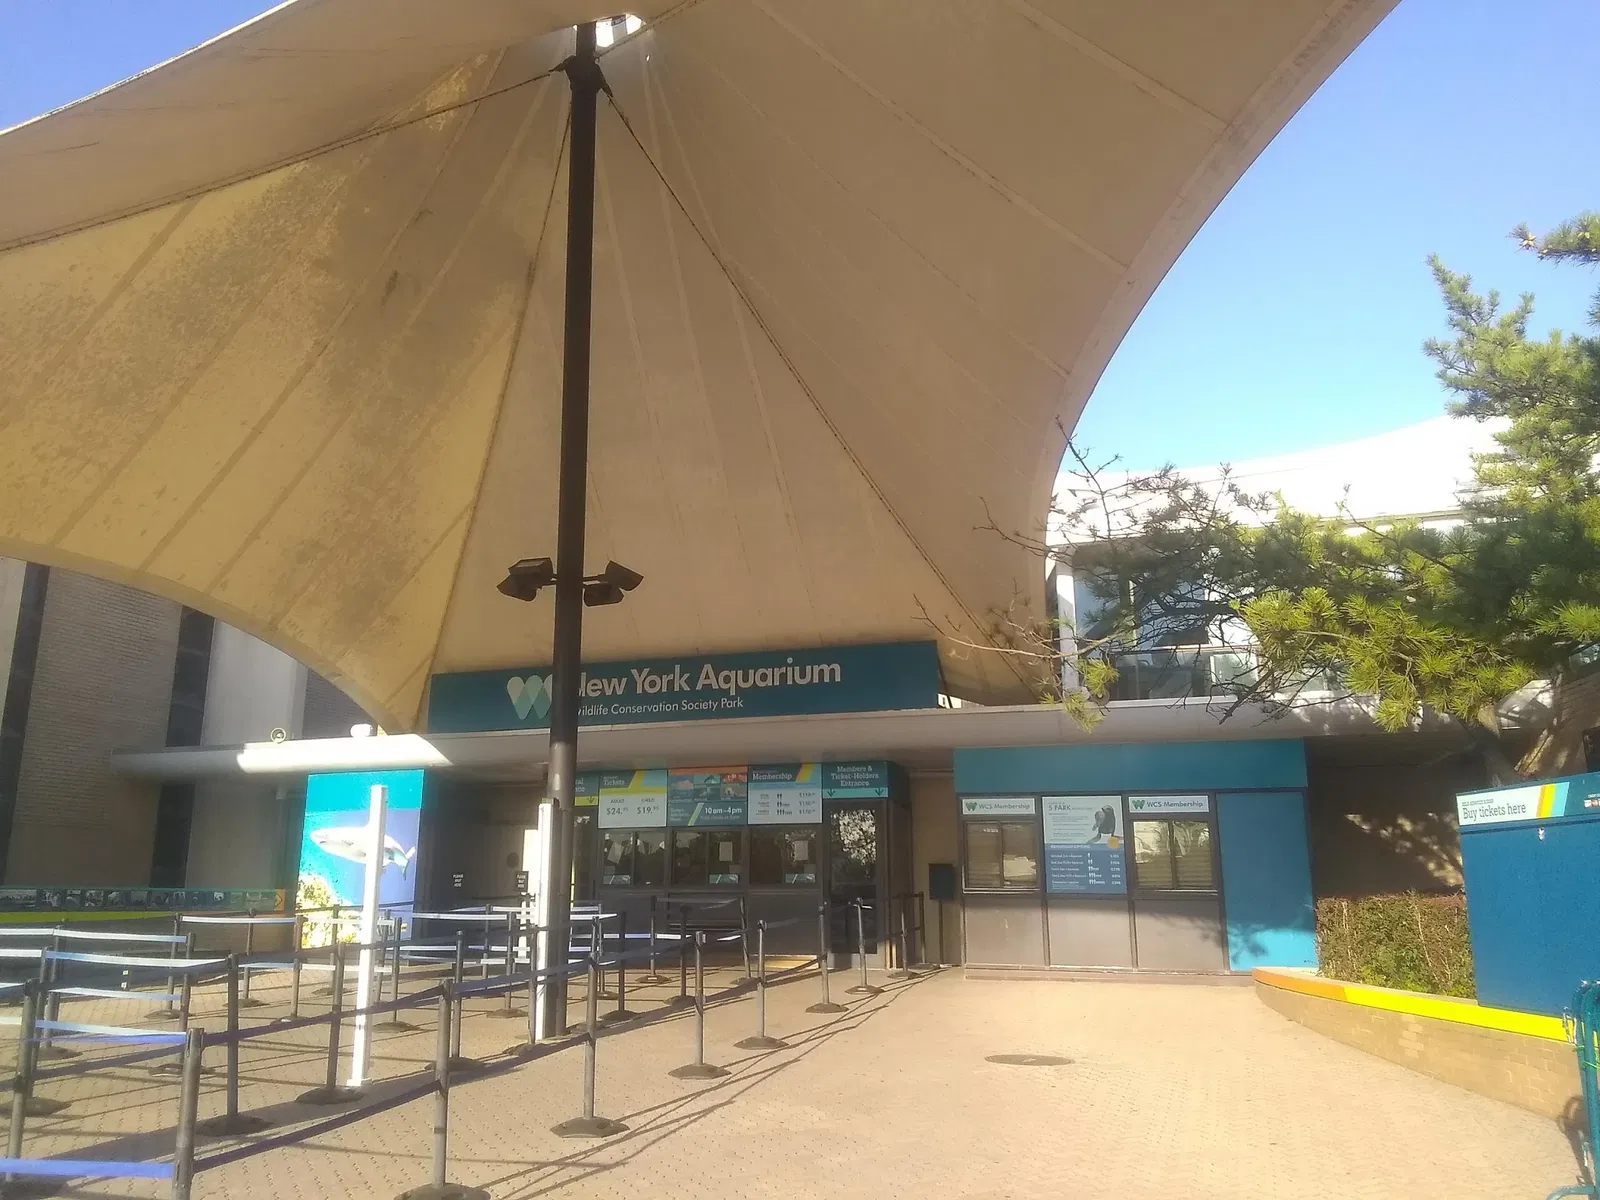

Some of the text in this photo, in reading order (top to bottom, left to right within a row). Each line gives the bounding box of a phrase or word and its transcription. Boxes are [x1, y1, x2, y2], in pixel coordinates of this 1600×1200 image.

[631, 664, 690, 694] York
[696, 657, 841, 696] Aquarium
[578, 697, 744, 716] ildlife Conservation Society Park
[752, 772, 793, 781] Membership
[1163, 800, 1204, 808] Membership
[1462, 803, 1527, 822] Buy tickets here
